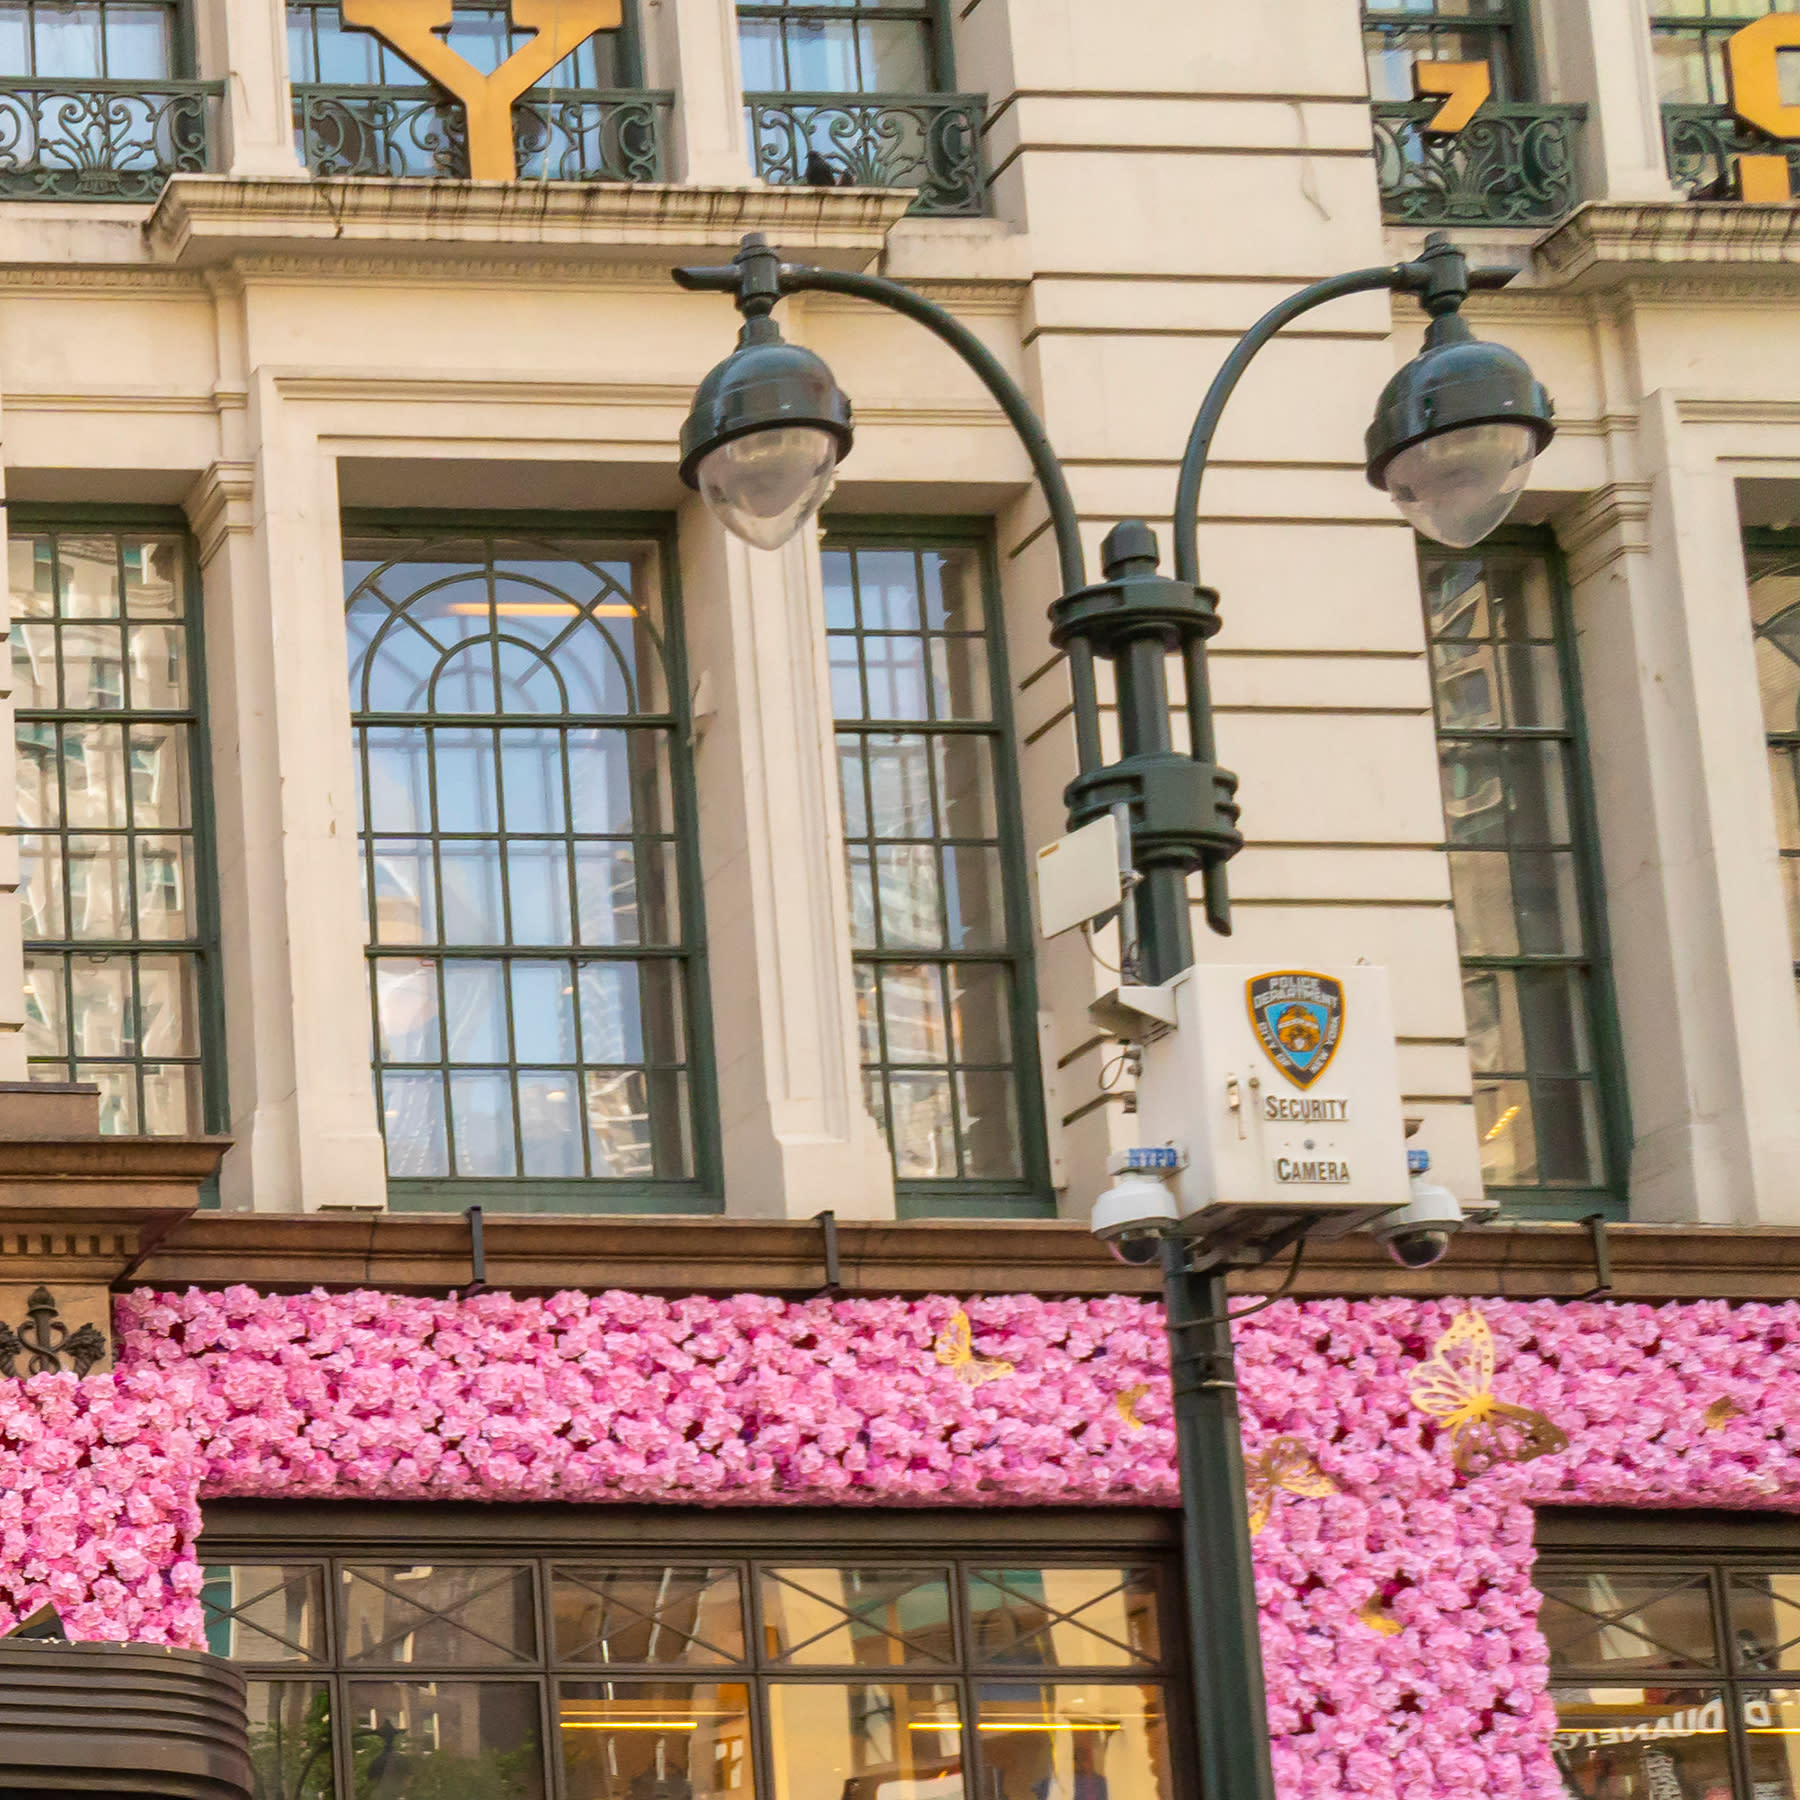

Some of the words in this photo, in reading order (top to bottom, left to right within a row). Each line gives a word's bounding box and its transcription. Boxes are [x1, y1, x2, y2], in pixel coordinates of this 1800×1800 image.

[1269, 976, 1321, 990] POLICE
[1253, 987, 1339, 1009] DEPARTMENT
[1264, 1095, 1349, 1120] SECURITY
[1277, 1157, 1349, 1182] CAMERA
